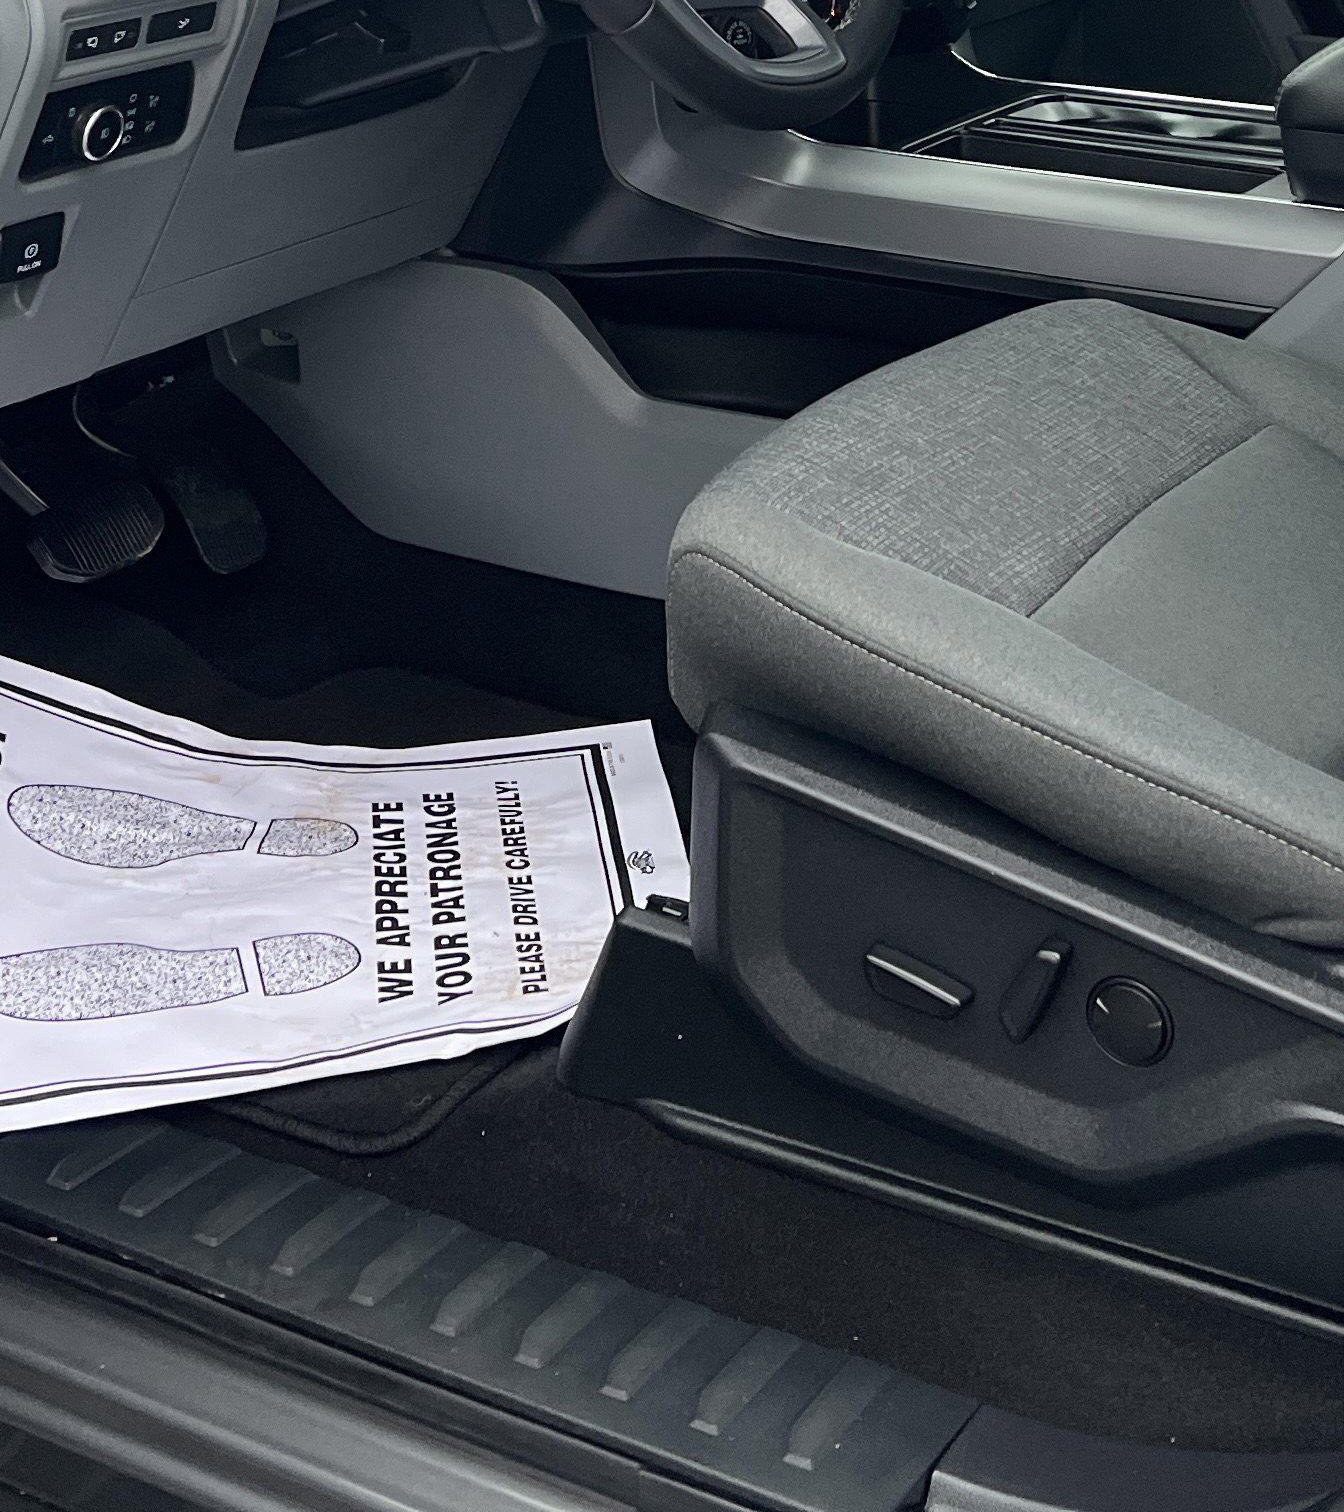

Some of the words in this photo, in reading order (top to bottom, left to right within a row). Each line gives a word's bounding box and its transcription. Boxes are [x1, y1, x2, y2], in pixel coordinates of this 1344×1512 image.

[422, 791, 467, 927] PATRONAGE
[494, 780, 532, 871] CAREFULLY!
[371, 801, 412, 948] APPRECIATE
[507, 874, 540, 926] DRIVE
[376, 957, 415, 1004] WE
[433, 931, 474, 1006] YOUR
[514, 931, 549, 996] PLEASE
